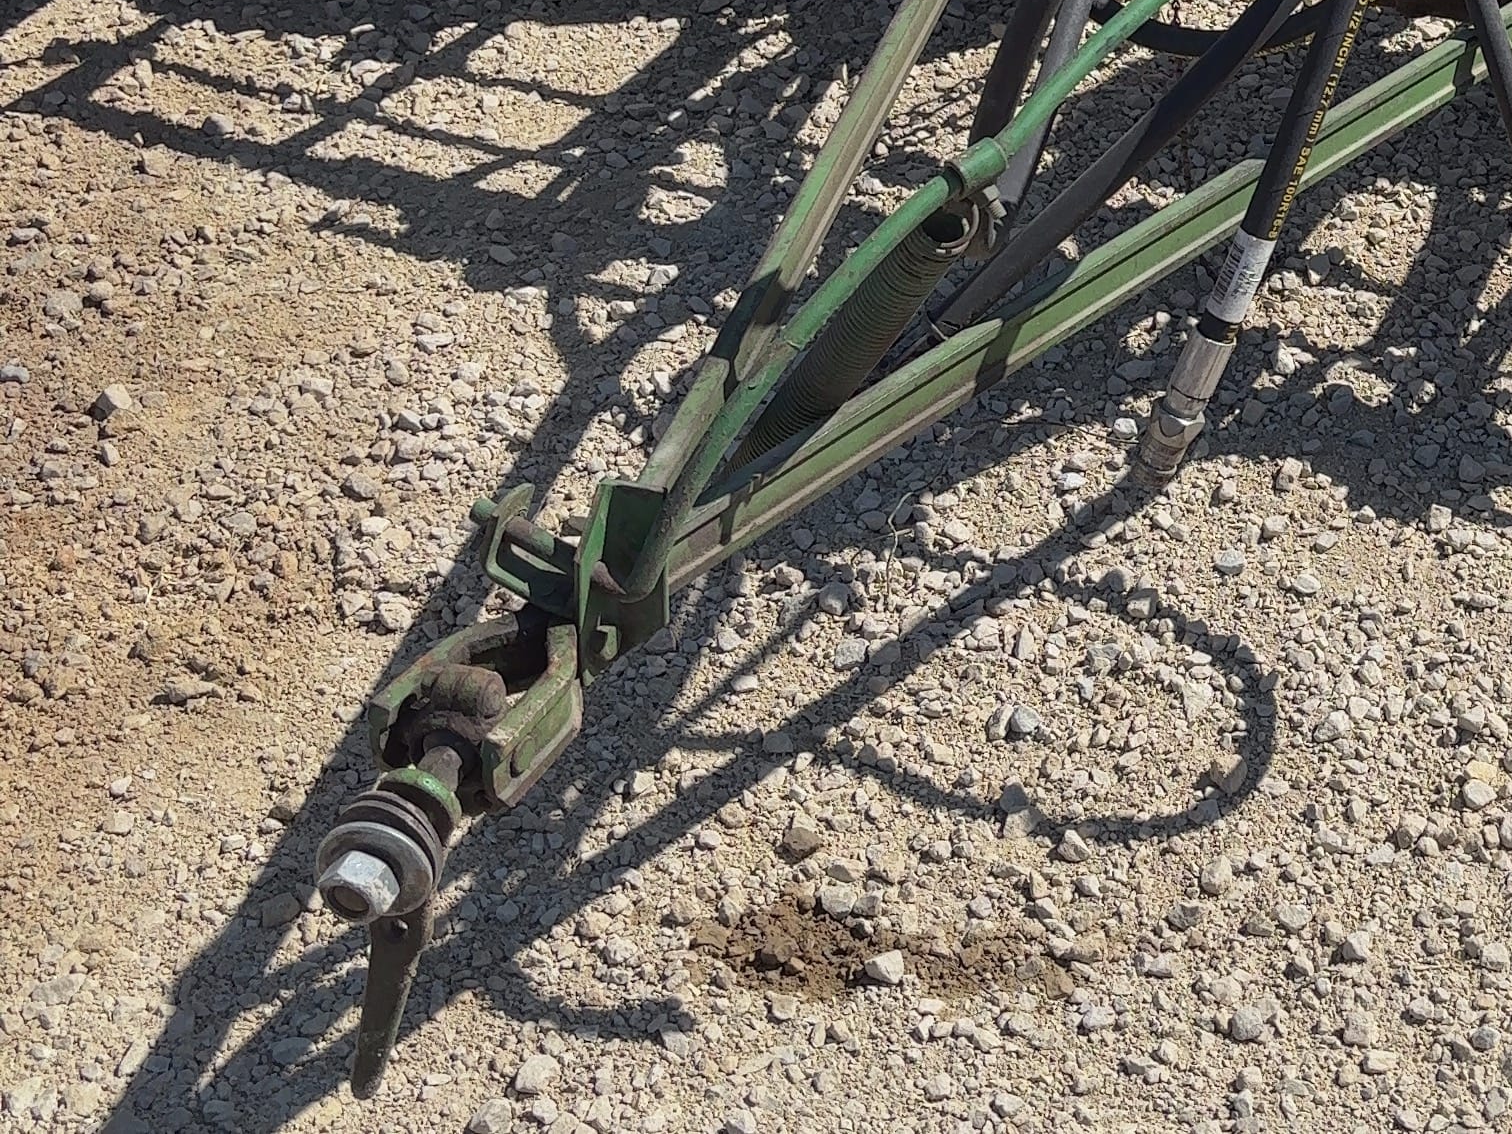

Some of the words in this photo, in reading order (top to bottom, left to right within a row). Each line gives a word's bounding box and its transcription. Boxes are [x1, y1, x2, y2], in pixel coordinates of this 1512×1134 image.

[1348, 10, 1362, 30] 1/2
[1334, 32, 1354, 68] INCH
[1293, 147, 1311, 175] SAE
